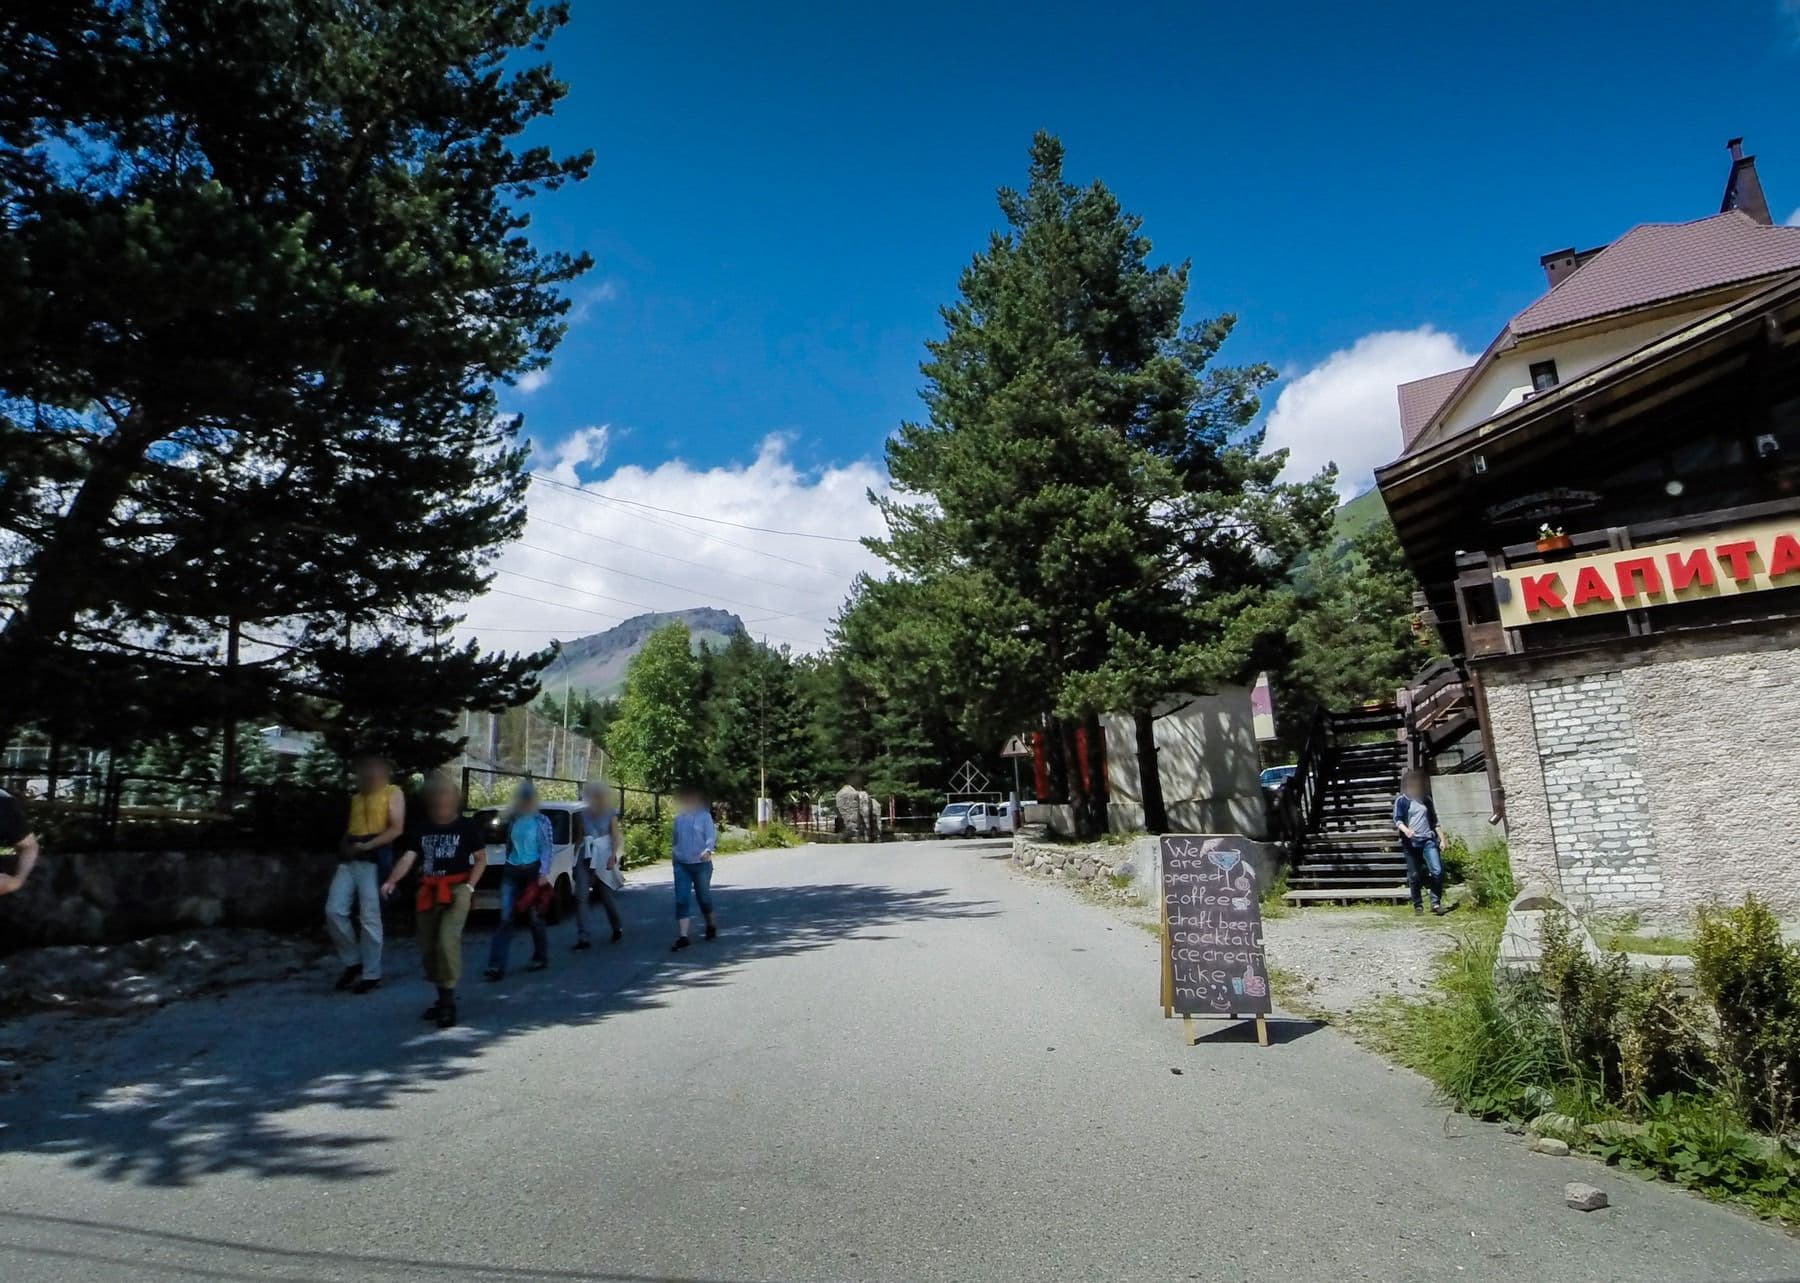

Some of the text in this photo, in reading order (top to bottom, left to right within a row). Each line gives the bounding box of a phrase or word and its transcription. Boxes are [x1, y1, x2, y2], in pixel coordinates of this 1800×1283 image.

[1520, 534, 1800, 613] КАПИТА
[1164, 838, 1199, 858] We
[1170, 859, 1202, 868] are
[1163, 868, 1224, 885] opened
[1165, 886, 1230, 906] coffee
[1167, 906, 1260, 931] draft beer
[1174, 928, 1262, 948] cocktail
[1174, 964, 1226, 983] Like
[1175, 986, 1208, 999] me
